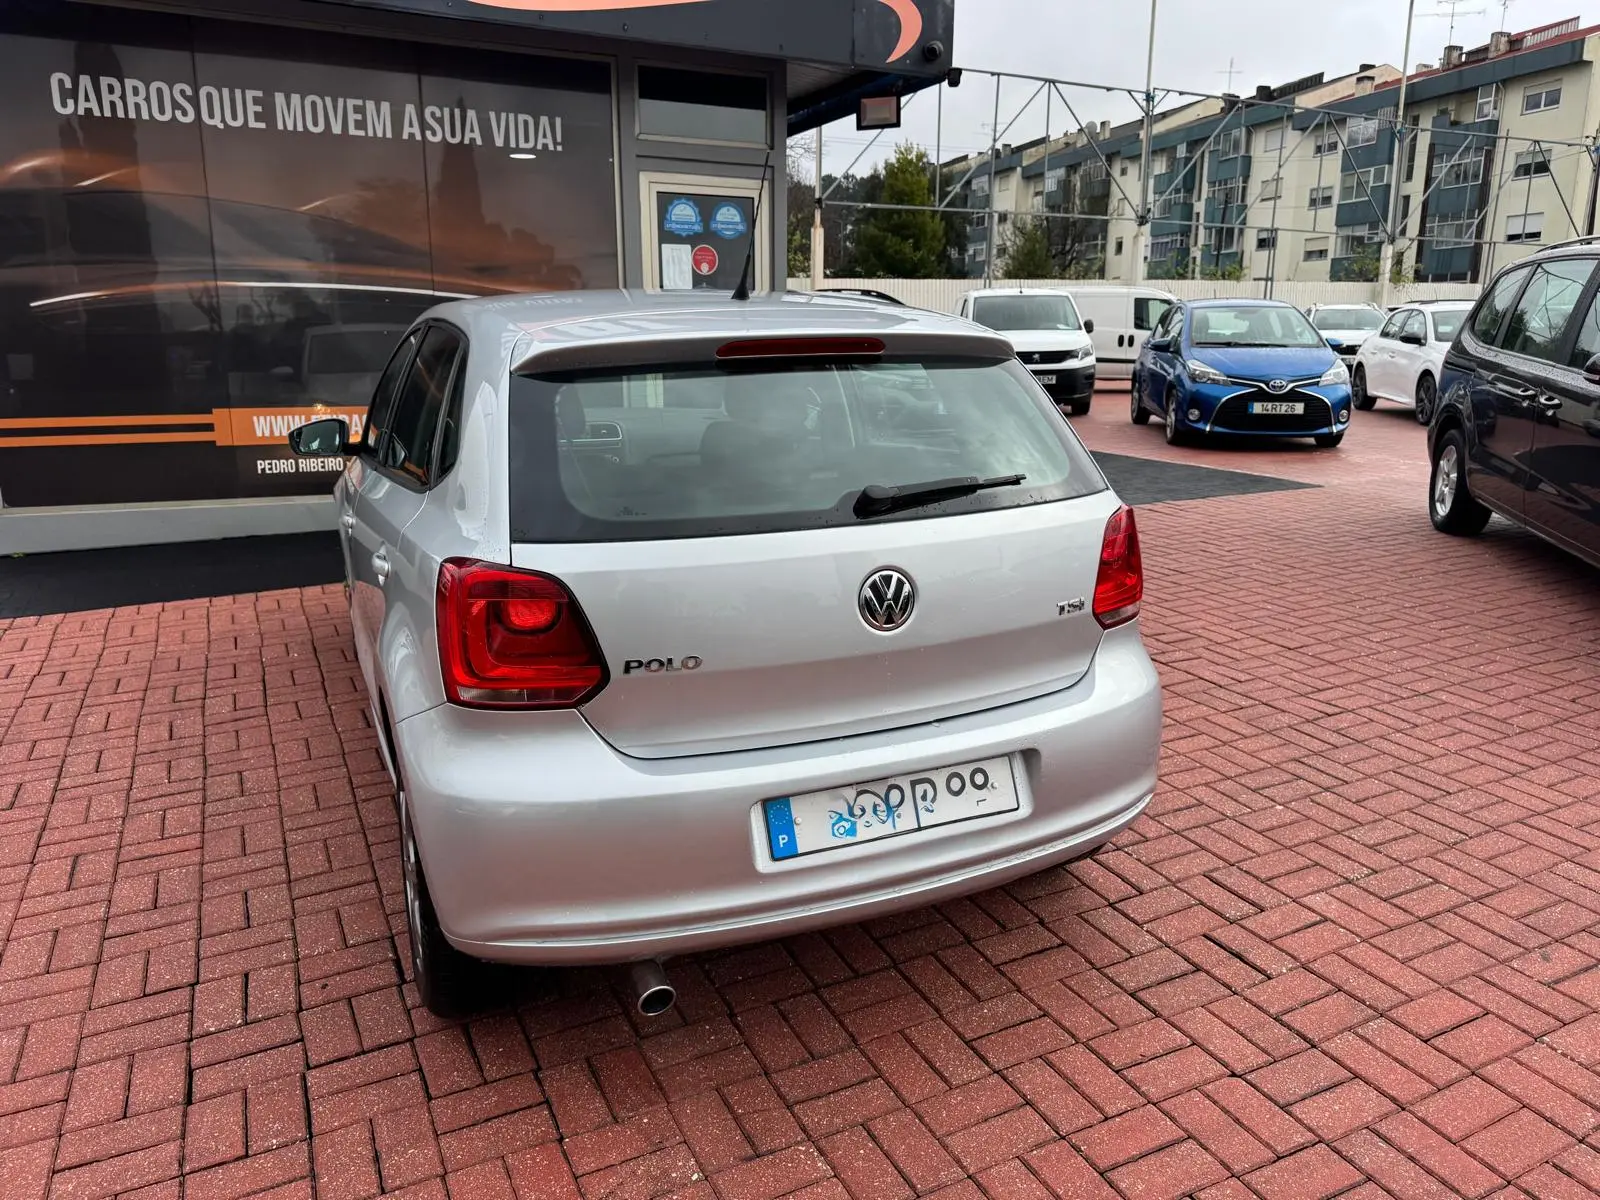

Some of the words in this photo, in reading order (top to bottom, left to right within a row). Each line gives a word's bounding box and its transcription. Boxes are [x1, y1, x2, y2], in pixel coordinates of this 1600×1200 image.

[50, 72, 195, 124] CARROS
[199, 85, 266, 129] QUE
[274, 92, 393, 139] MOVEM
[489, 111, 563, 152] VIDA!
[257, 460, 296, 474] PEDRO
[299, 457, 344, 472] RIBEIRO
[623, 655, 703, 675] POLO
[778, 834, 789, 848] P
